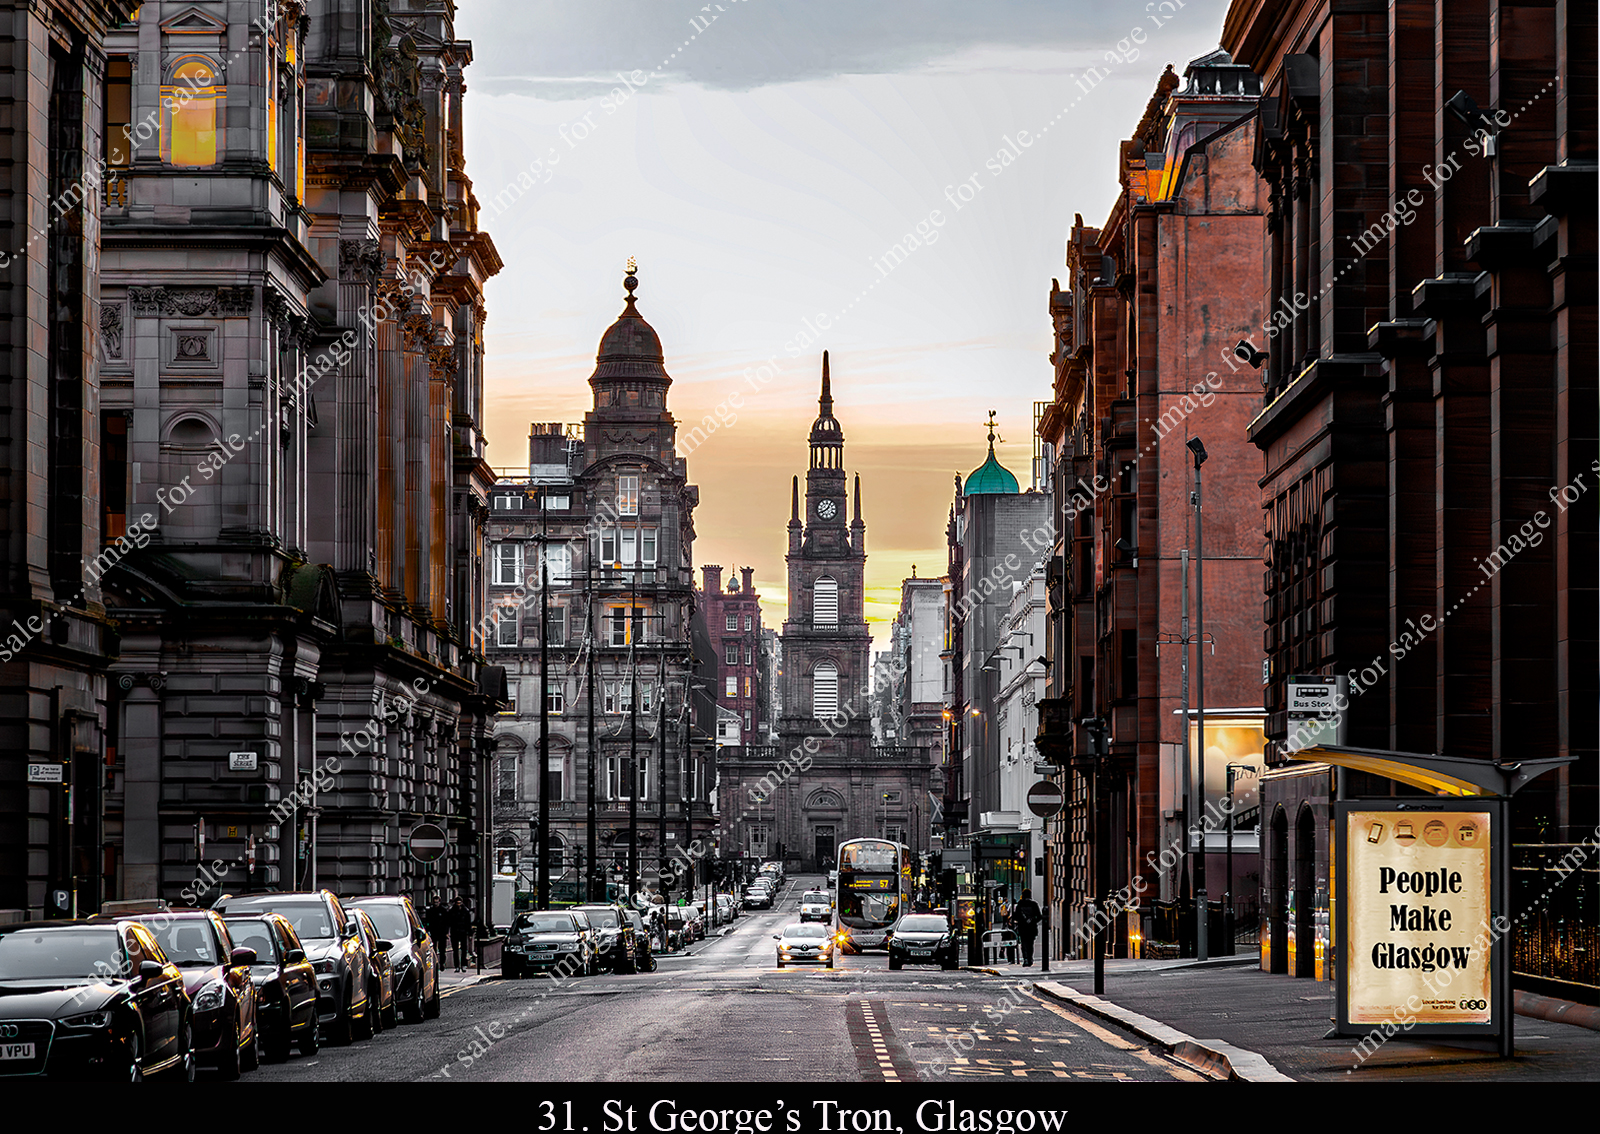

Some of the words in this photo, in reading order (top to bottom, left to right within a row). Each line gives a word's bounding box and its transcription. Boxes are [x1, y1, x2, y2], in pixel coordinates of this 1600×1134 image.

[880, 880, 889, 888] 57
[1379, 867, 1462, 897] People
[1390, 905, 1452, 931] Make
[1372, 942, 1470, 973] Glasgow
